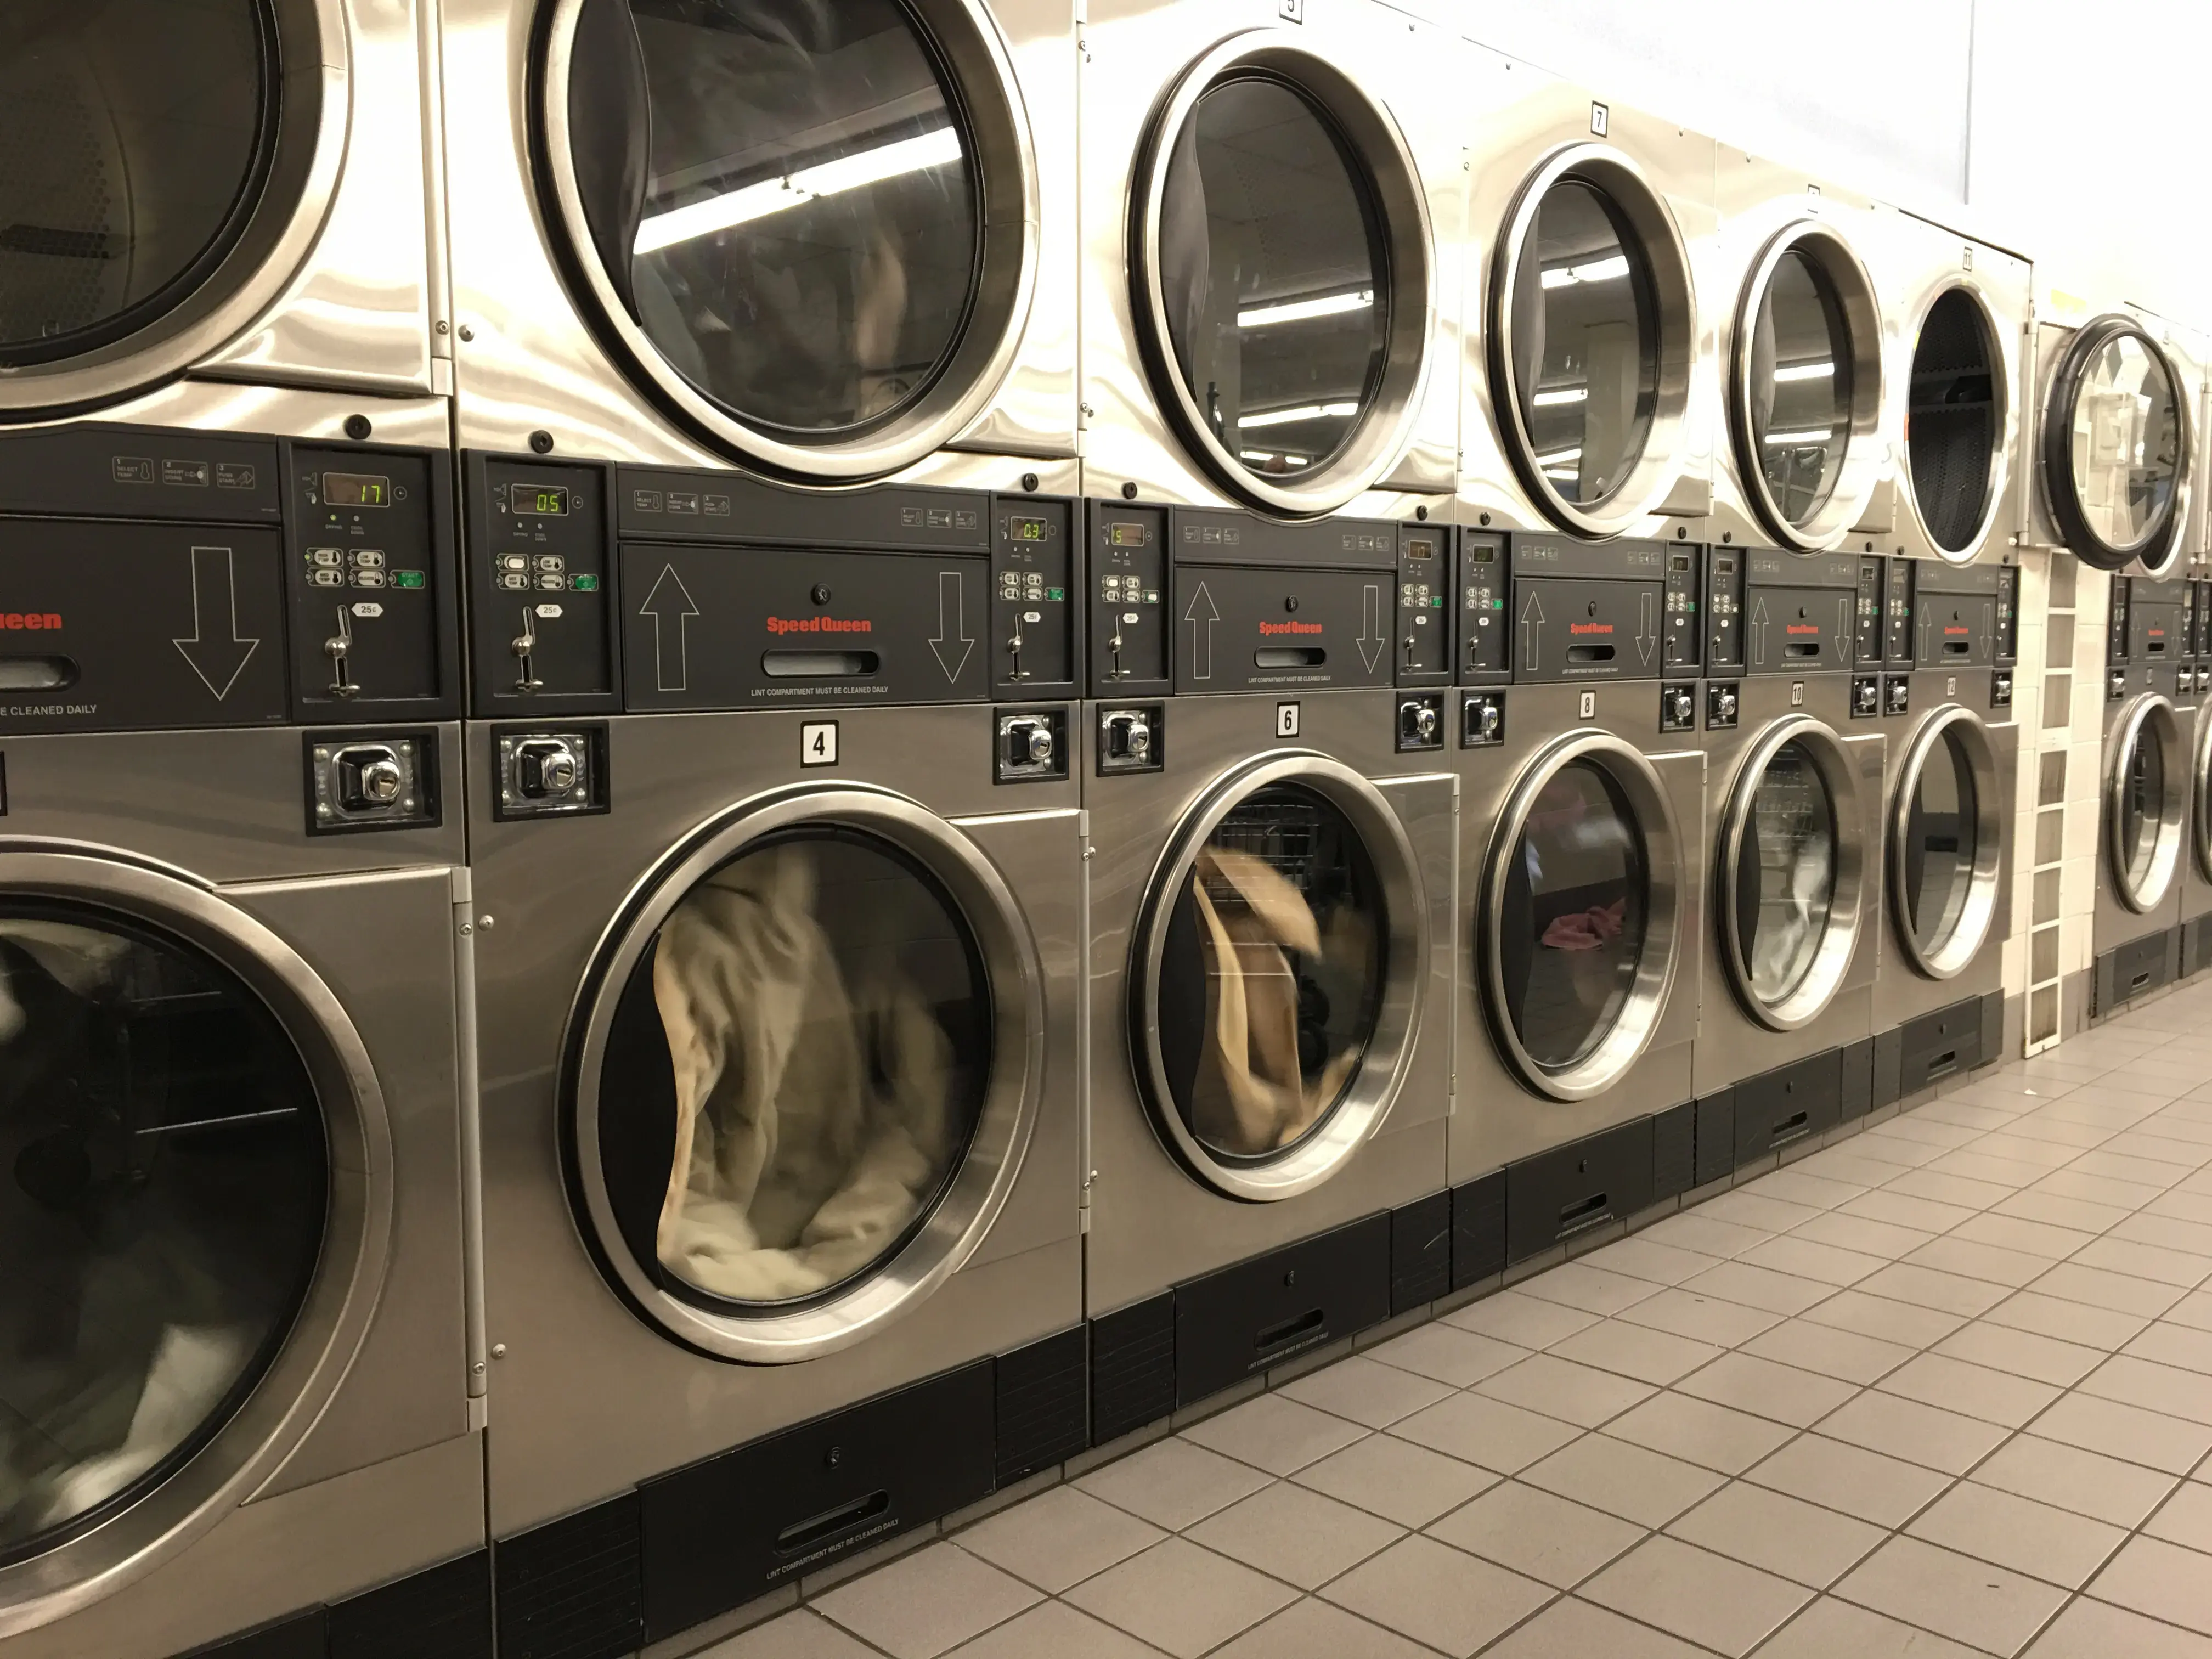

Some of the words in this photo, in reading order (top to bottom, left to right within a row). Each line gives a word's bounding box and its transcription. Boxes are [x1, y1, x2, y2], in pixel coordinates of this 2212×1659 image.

[1597, 111, 1602, 128] 7
[1965, 253, 1971, 266] 11
[362, 485, 380, 503] 17
[537, 494, 558, 512] 05
[1024, 523, 1039, 538] 03
[766, 687, 814, 696] COMPARTMENT
[843, 686, 871, 694] CLEANED
[1793, 686, 1802, 701] 10
[1948, 680, 1955, 692] 12
[10, 705, 64, 716] CLEANED
[66, 704, 97, 714] DAILY
[1585, 697, 1590, 713] 8
[1284, 710, 1292, 730] 6
[812, 731, 825, 755] 4
[766, 1568, 781, 1580] LINT
[781, 1548, 828, 1573] COMPARTMENT
[828, 1541, 845, 1553] MUST
[845, 1537, 854, 1546] BE
[855, 1525, 883, 1542] CLEANED
[883, 1517, 899, 1531] DAILY
